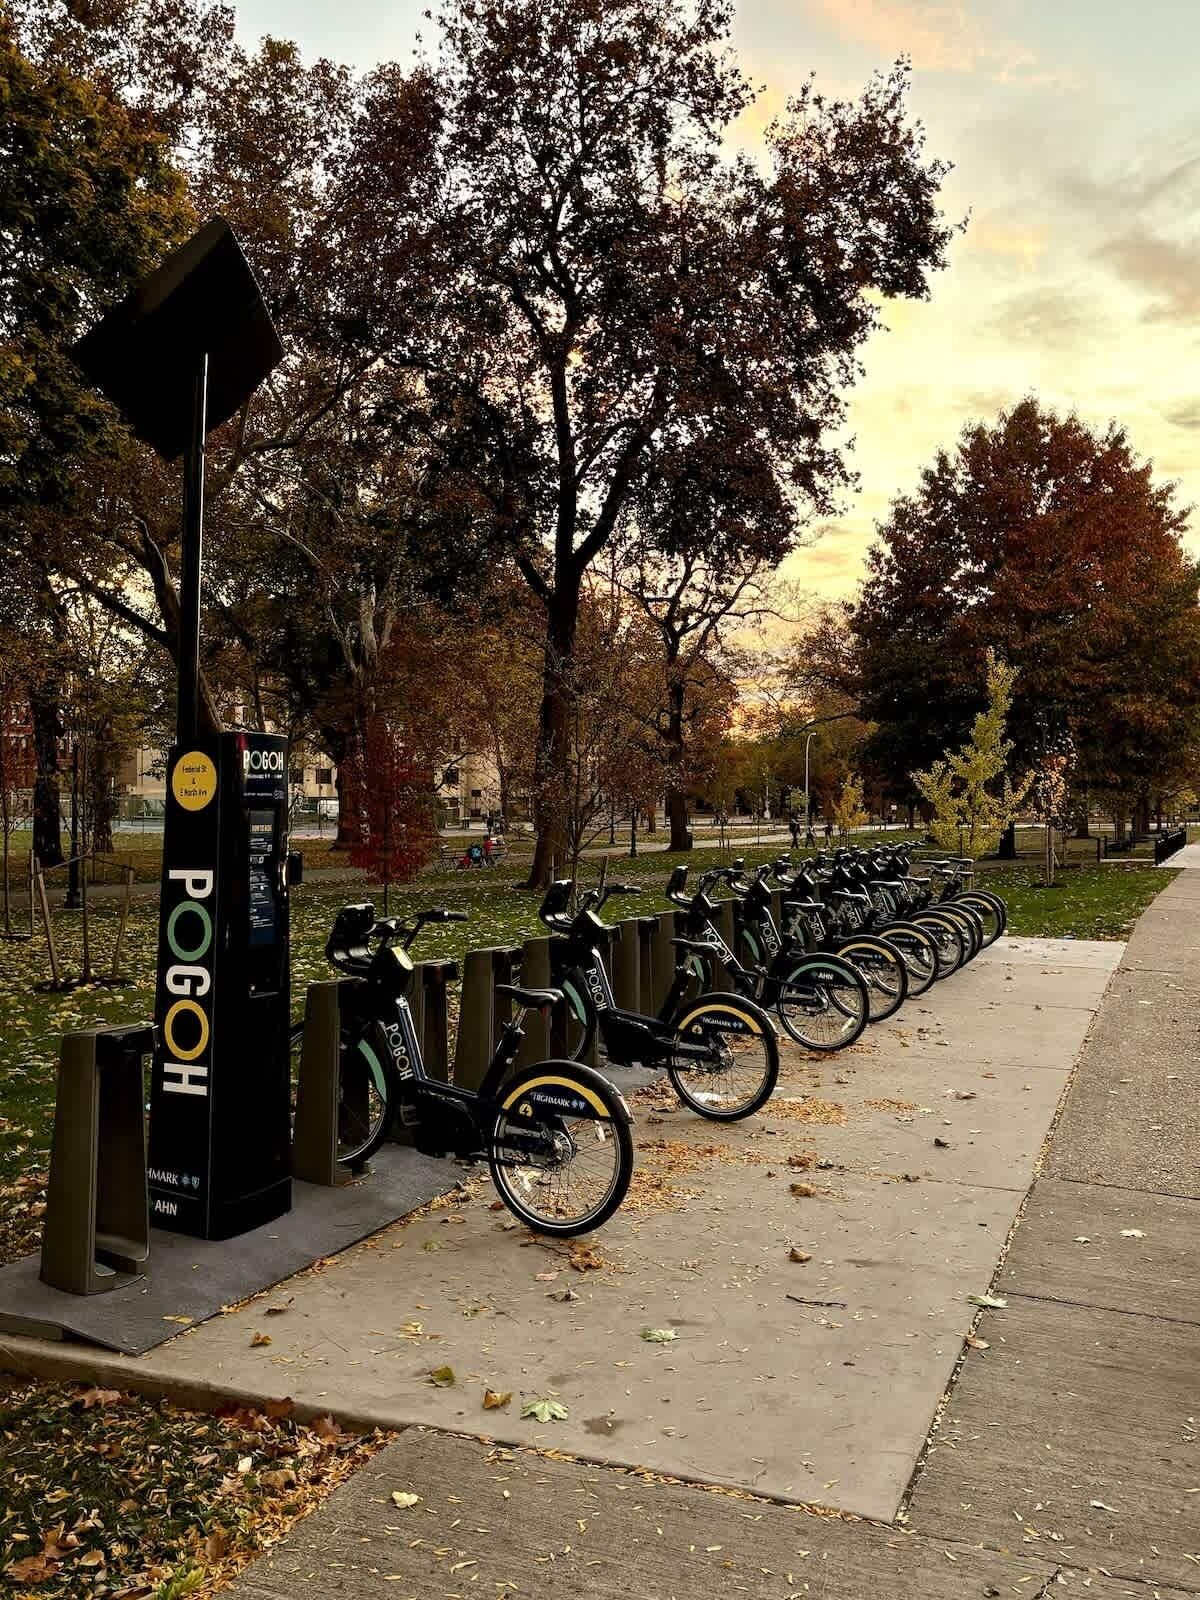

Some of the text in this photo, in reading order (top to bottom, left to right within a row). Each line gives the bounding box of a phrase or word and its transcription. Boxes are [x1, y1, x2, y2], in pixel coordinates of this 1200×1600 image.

[243, 750, 284, 771] POGOH
[760, 922, 779, 958] POGOH
[808, 915, 825, 942] OGOH
[702, 927, 733, 965] POOH
[162, 869, 214, 1096] POGOH
[586, 968, 608, 1011] POGOH
[818, 972, 834, 980] AHN
[386, 1023, 414, 1081] POGOH
[145, 1168, 178, 1186] HMARK
[155, 1199, 177, 1216] AHN
